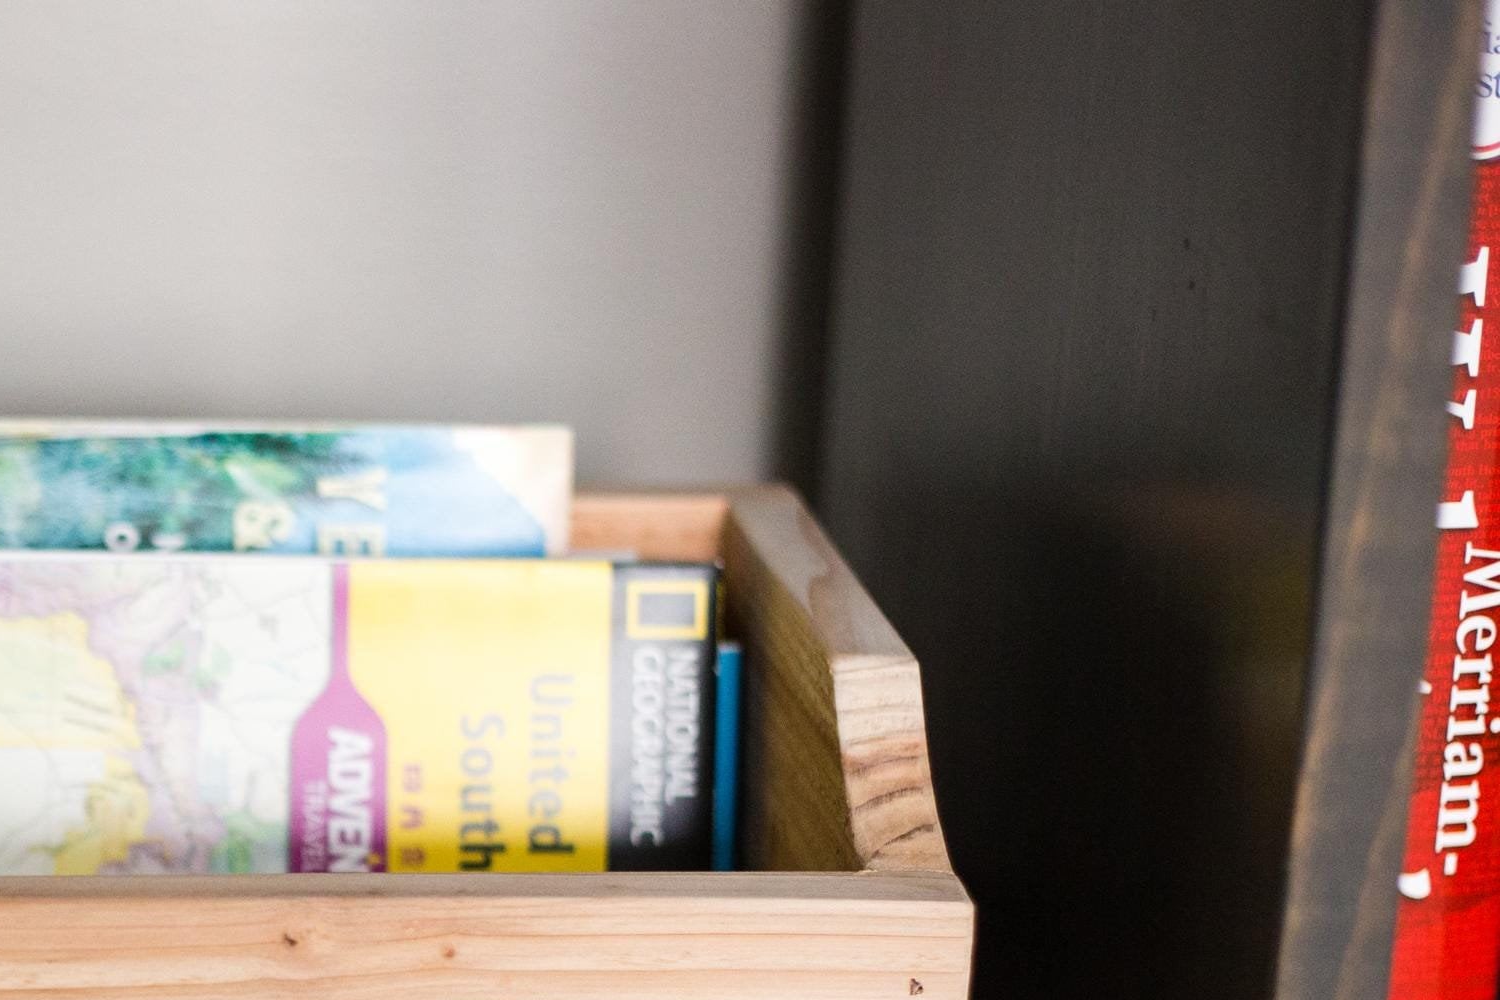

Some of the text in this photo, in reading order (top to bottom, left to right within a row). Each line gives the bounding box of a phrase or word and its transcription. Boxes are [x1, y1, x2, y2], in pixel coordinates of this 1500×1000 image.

[458, 714, 507, 872] South
[528, 674, 576, 855] United
[630, 647, 665, 848] GEOGRAPHIC
[665, 647, 700, 806] NATIONAL
